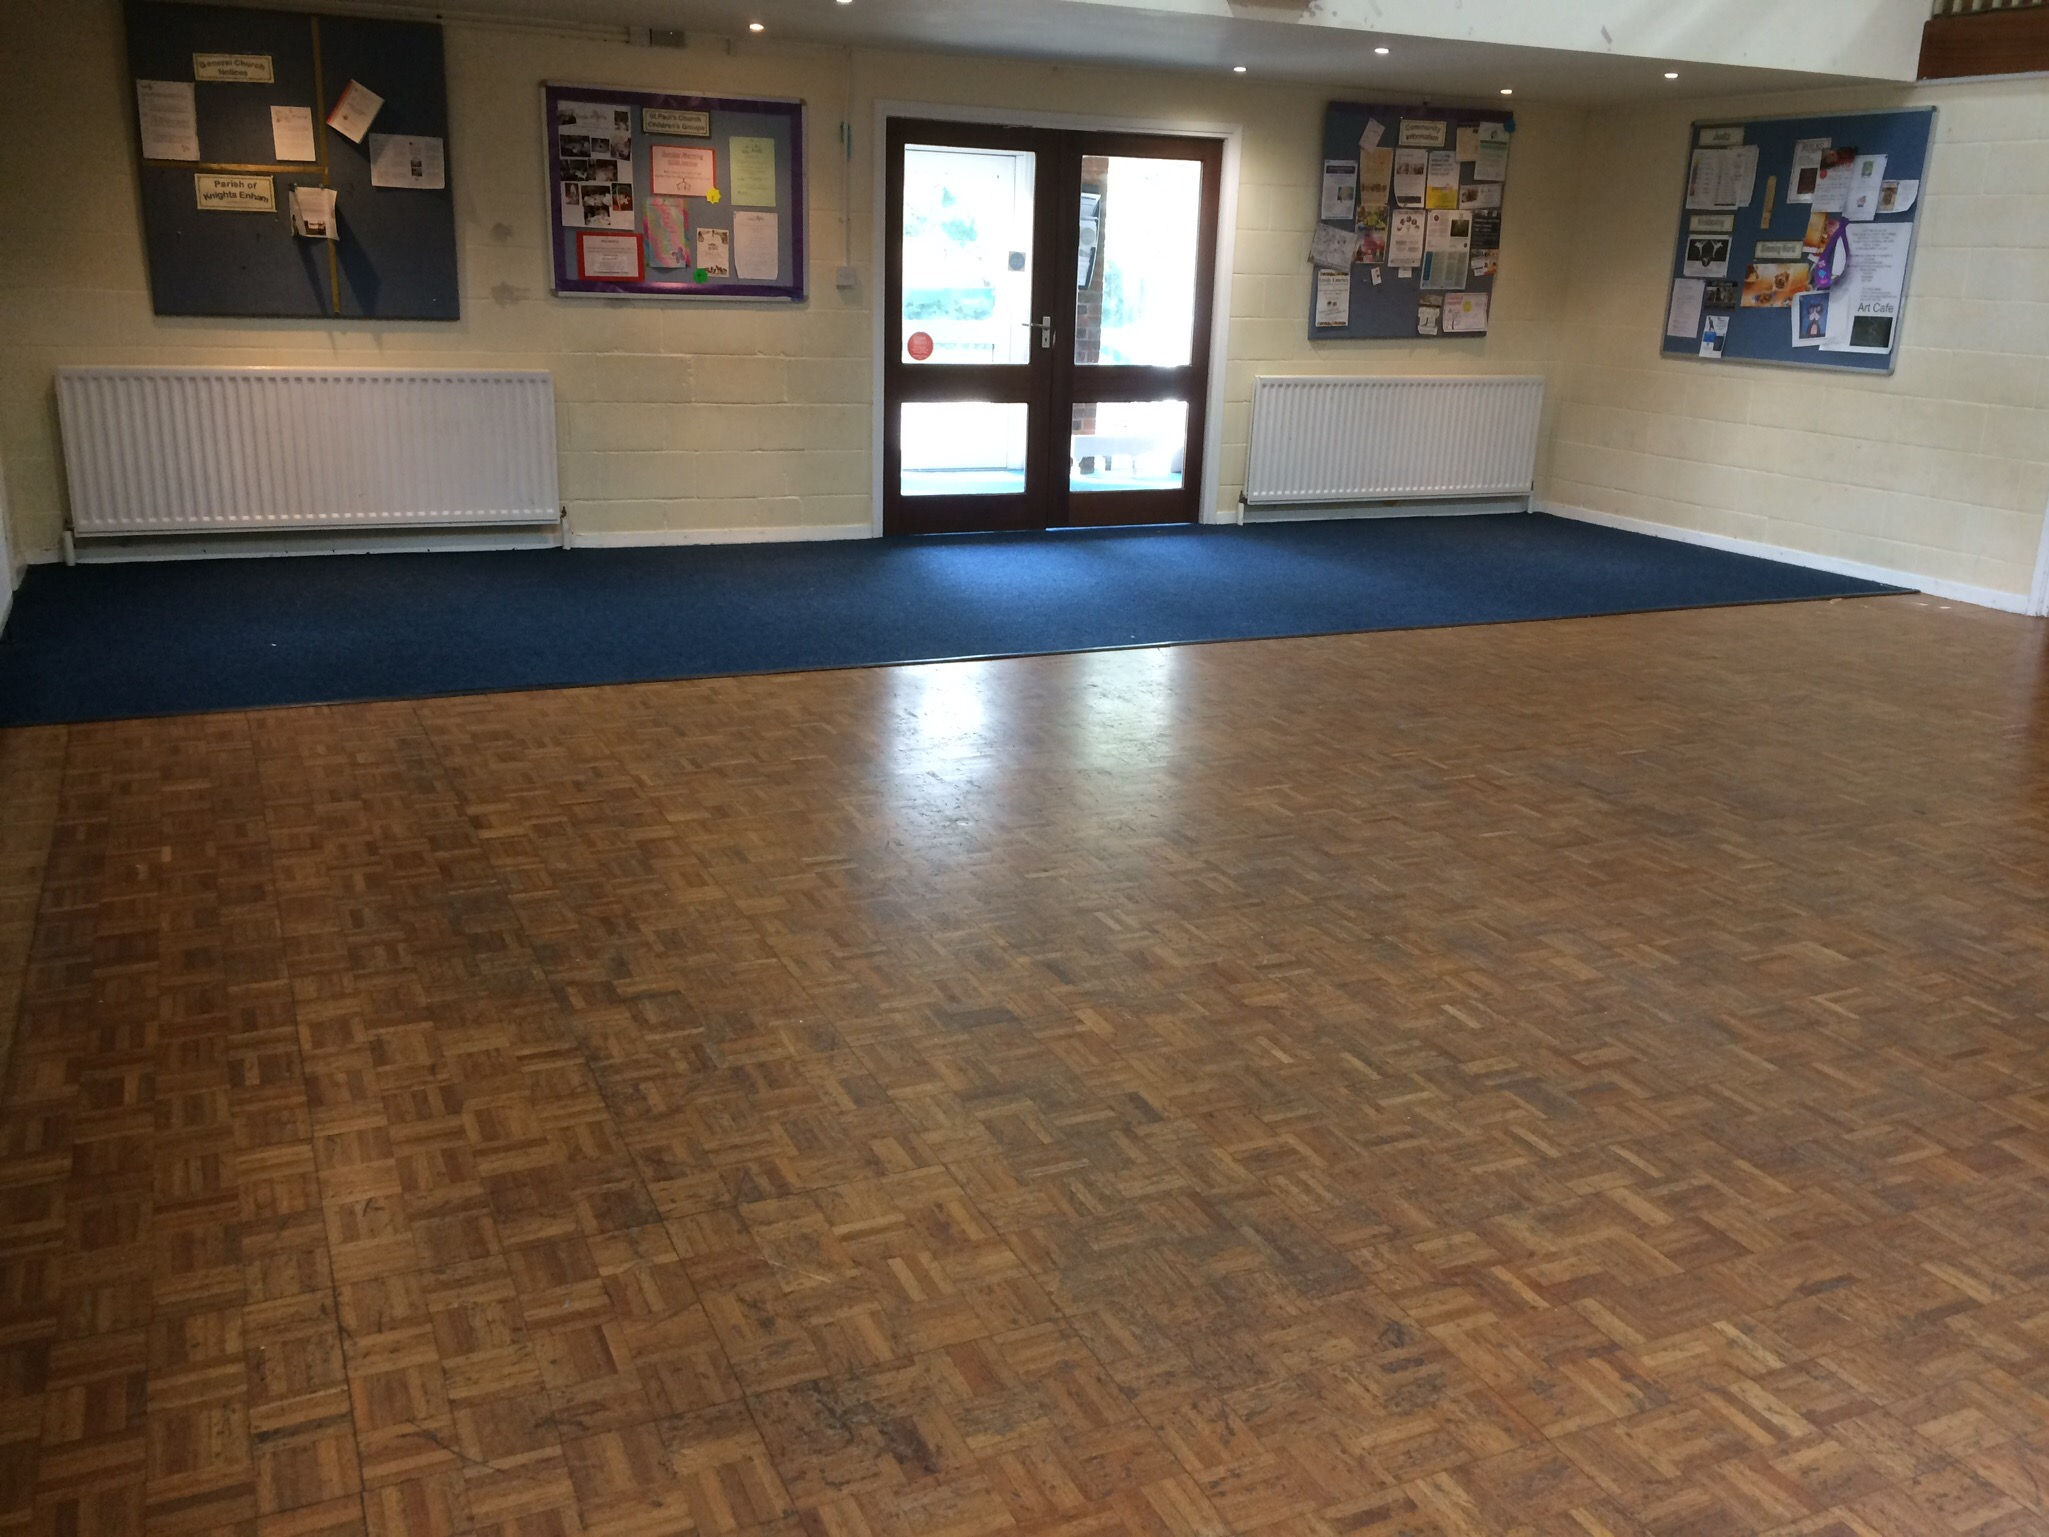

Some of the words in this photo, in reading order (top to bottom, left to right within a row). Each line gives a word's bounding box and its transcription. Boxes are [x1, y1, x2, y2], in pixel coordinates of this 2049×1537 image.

[199, 60, 233, 69] General
[234, 59, 265, 70] Church
[218, 68, 248, 76] Notices
[647, 121, 681, 129] Children's
[681, 123, 706, 131] Groups
[1405, 123, 1441, 134] Community
[214, 180, 245, 188] Parish
[247, 182, 258, 190] of
[203, 190, 238, 201] Knights
[239, 191, 269, 203] Enham
[1857, 302, 1871, 312] Art
[1872, 302, 1894, 313] Cafe
